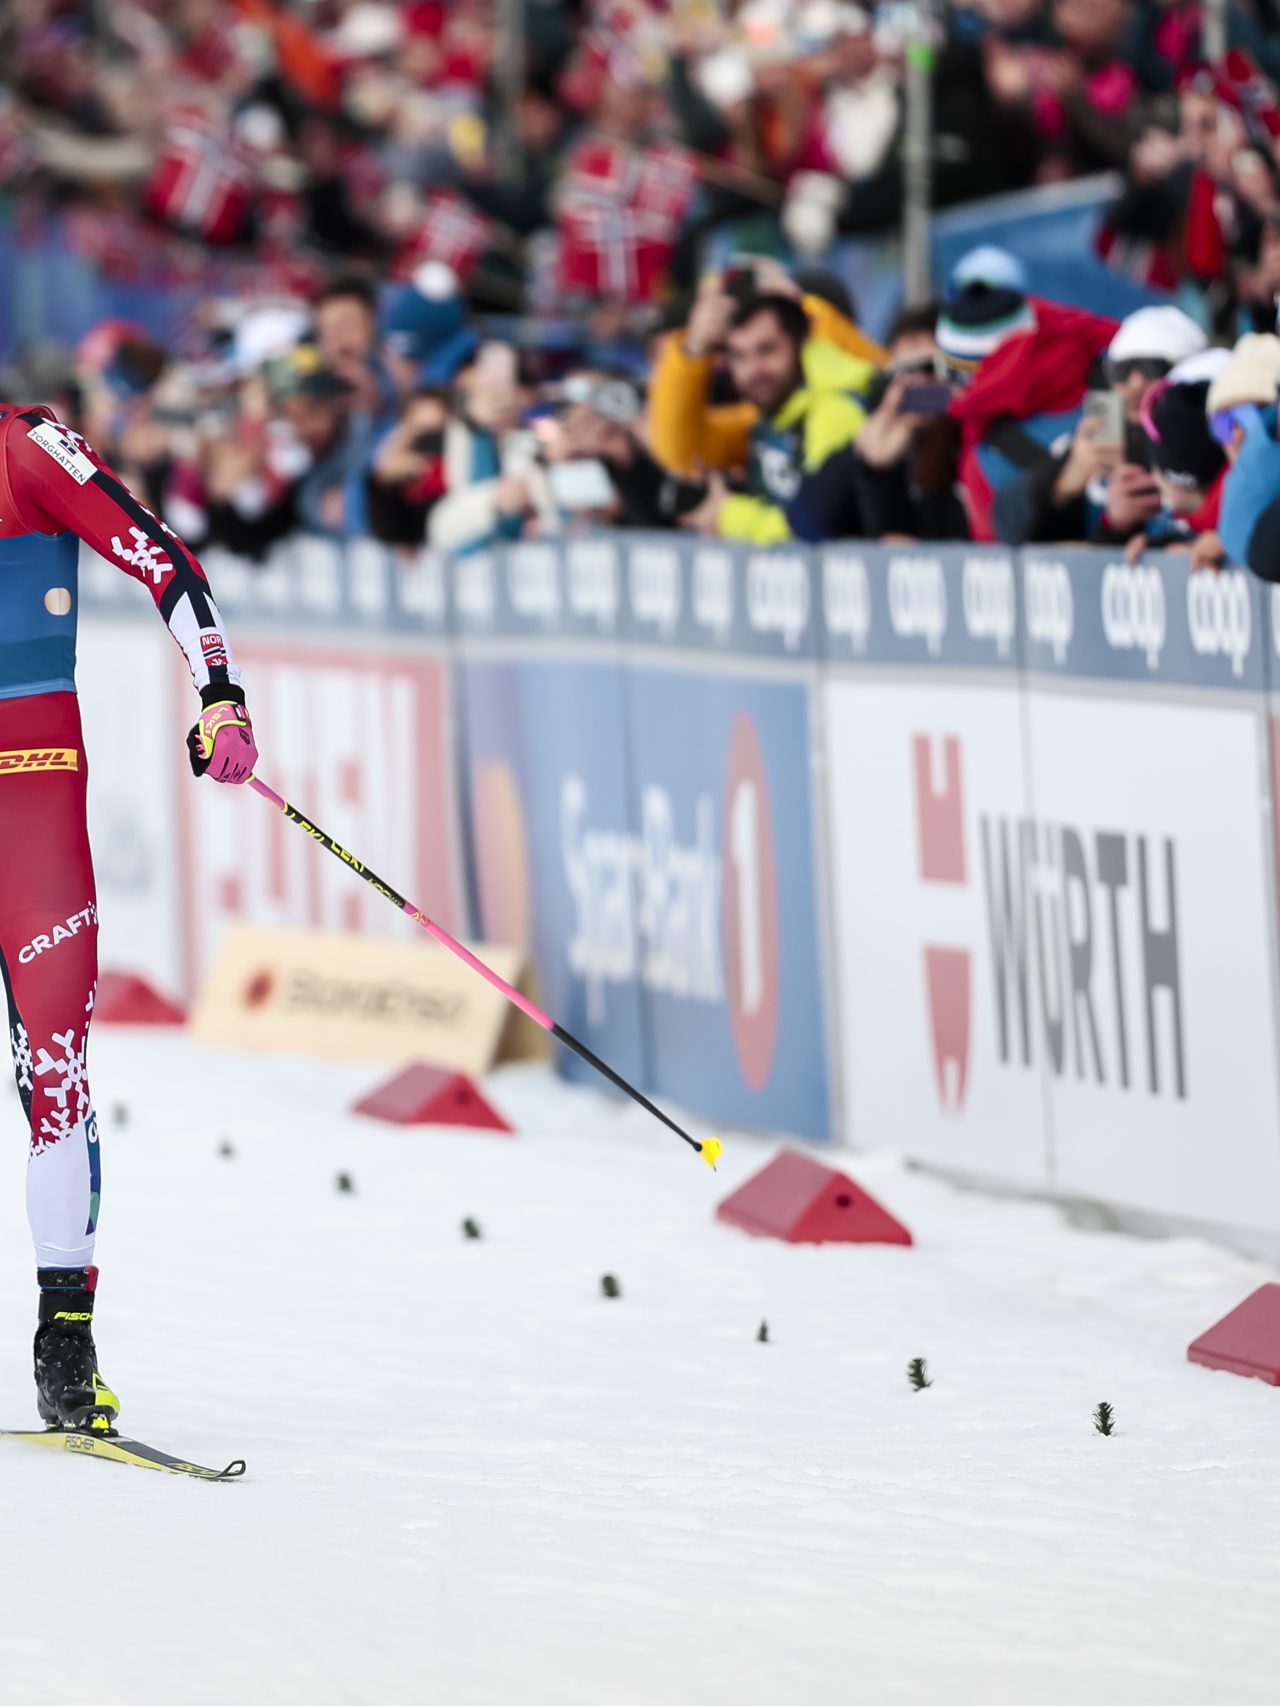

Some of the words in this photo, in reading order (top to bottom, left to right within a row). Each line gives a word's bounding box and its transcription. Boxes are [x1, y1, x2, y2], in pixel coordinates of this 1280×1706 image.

[31, 430, 87, 483] TORGHATTEN
[201, 635, 222, 647] NOR
[1100, 563, 1166, 671] coop
[1186, 569, 1252, 678] coop
[206, 707, 228, 735] LEKI
[732, 780, 761, 1018] 1
[18, 911, 92, 964] CRAFT
[64, 1435, 95, 1451] FISCHER
